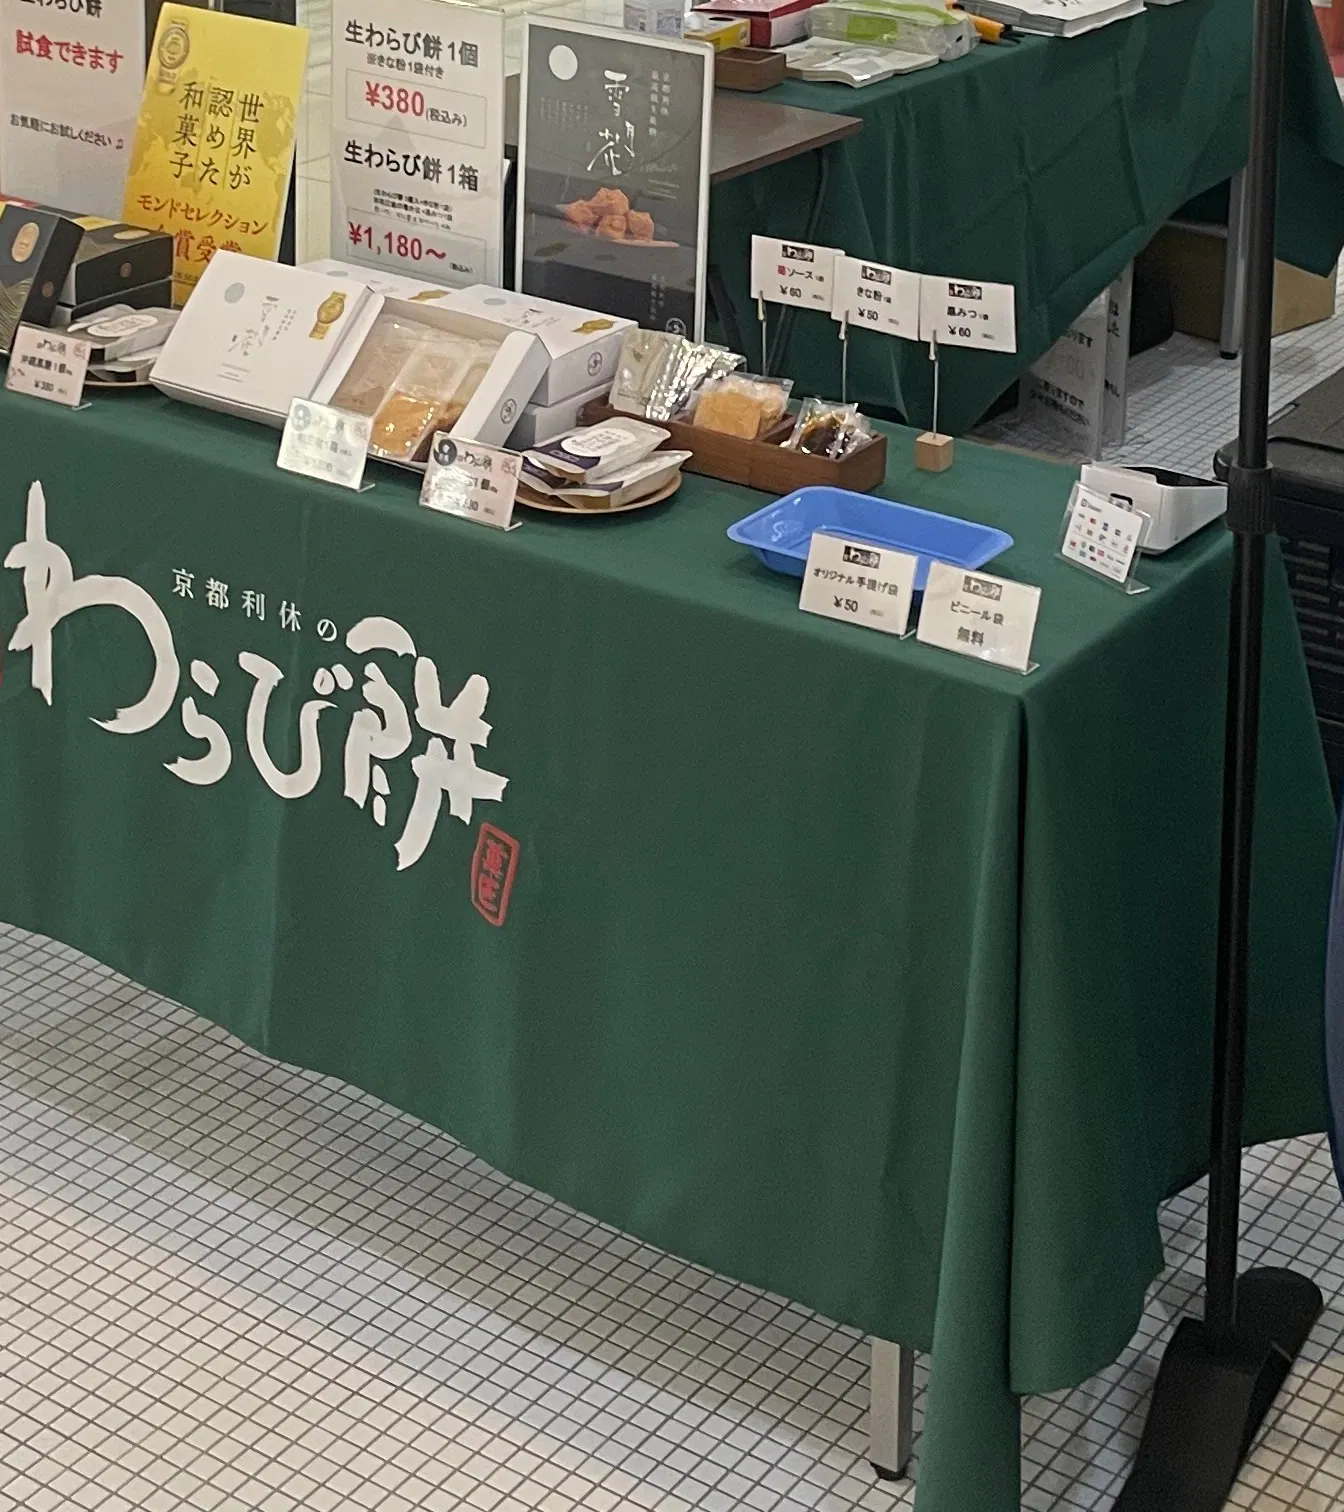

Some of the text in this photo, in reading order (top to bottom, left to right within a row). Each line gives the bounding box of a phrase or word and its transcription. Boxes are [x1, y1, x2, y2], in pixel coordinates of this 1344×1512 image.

[16, 29, 125, 74] 試食できます
[169, 81, 204, 179] 和菓子
[365, 80, 425, 116] ¥380
[199, 86, 234, 186] 認めた
[228, 92, 264, 190] 世界が
[137, 194, 269, 235] モンドセレクション
[171, 568, 338, 642] 京都利休の
[833, 595, 859, 613] ¥50
[3, 479, 510, 871] わらび餅
